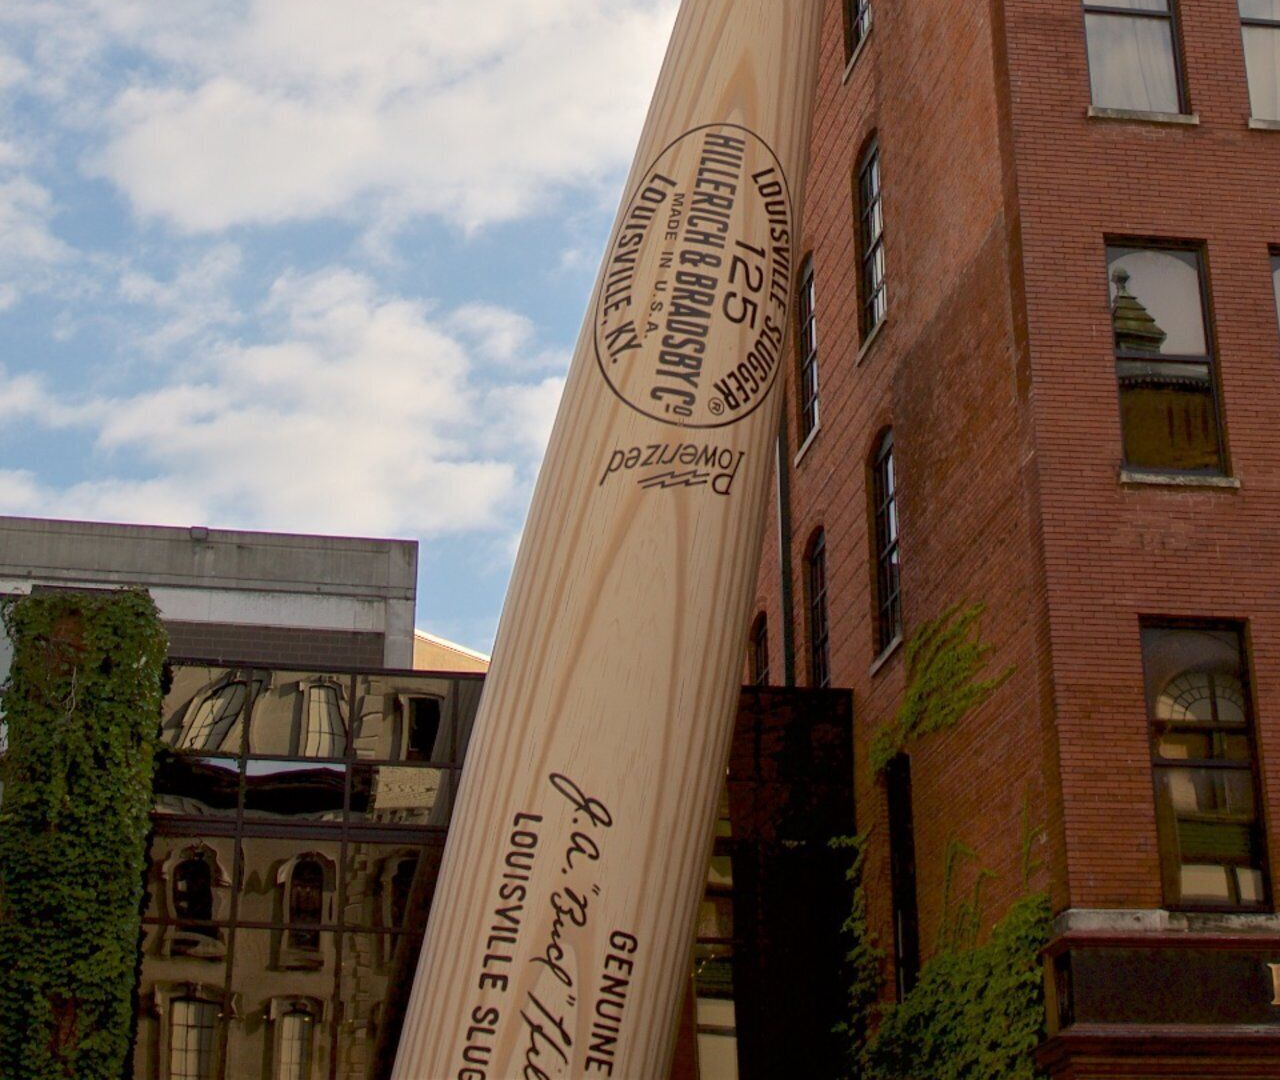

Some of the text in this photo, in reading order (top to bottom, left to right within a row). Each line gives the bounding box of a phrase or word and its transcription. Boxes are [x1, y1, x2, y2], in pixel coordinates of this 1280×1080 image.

[683, 132, 746, 249] HILLERICH
[751, 167, 790, 315] LOUISVILLE
[601, 172, 678, 365] LOUISVILLE, KY.
[643, 192, 685, 339] MADE IN U.S.A.
[679, 249, 722, 269] &
[723, 239, 766, 330] 125
[655, 270, 718, 390] BRADSBY
[599, 442, 746, 496] Powerized
[478, 811, 544, 993] LOUISVILLE
[584, 929, 639, 1078] GENUINE
